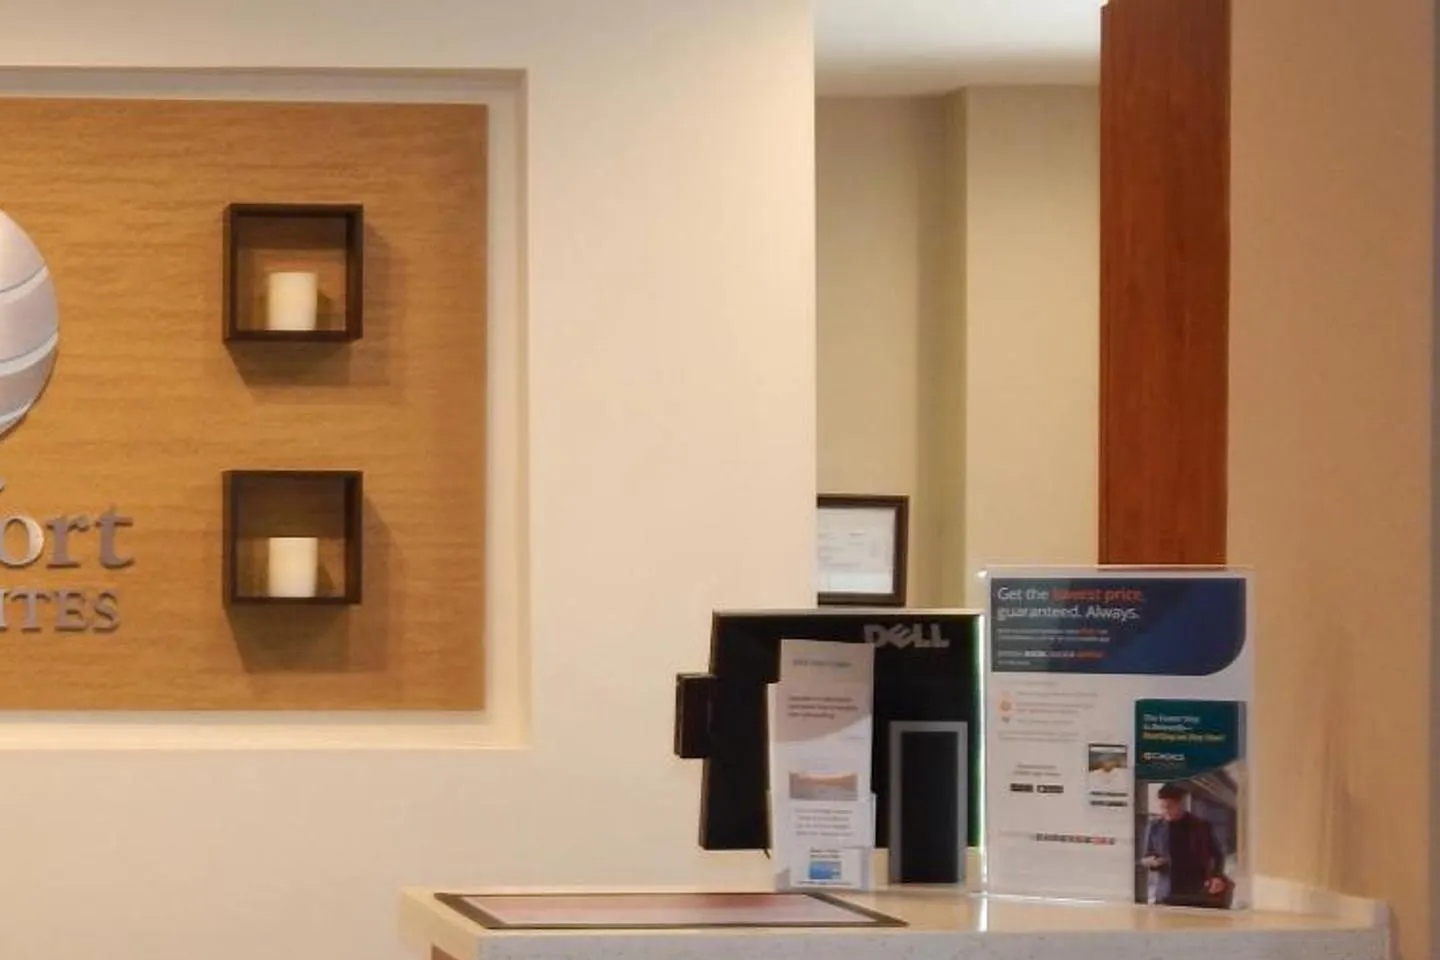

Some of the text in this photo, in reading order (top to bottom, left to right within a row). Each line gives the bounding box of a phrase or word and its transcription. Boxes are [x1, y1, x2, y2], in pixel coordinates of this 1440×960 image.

[997, 586, 1022, 600] Get
[1025, 587, 1050, 600] the
[996, 605, 1140, 621] guaranteed. Always.
[863, 623, 950, 649] DELL
